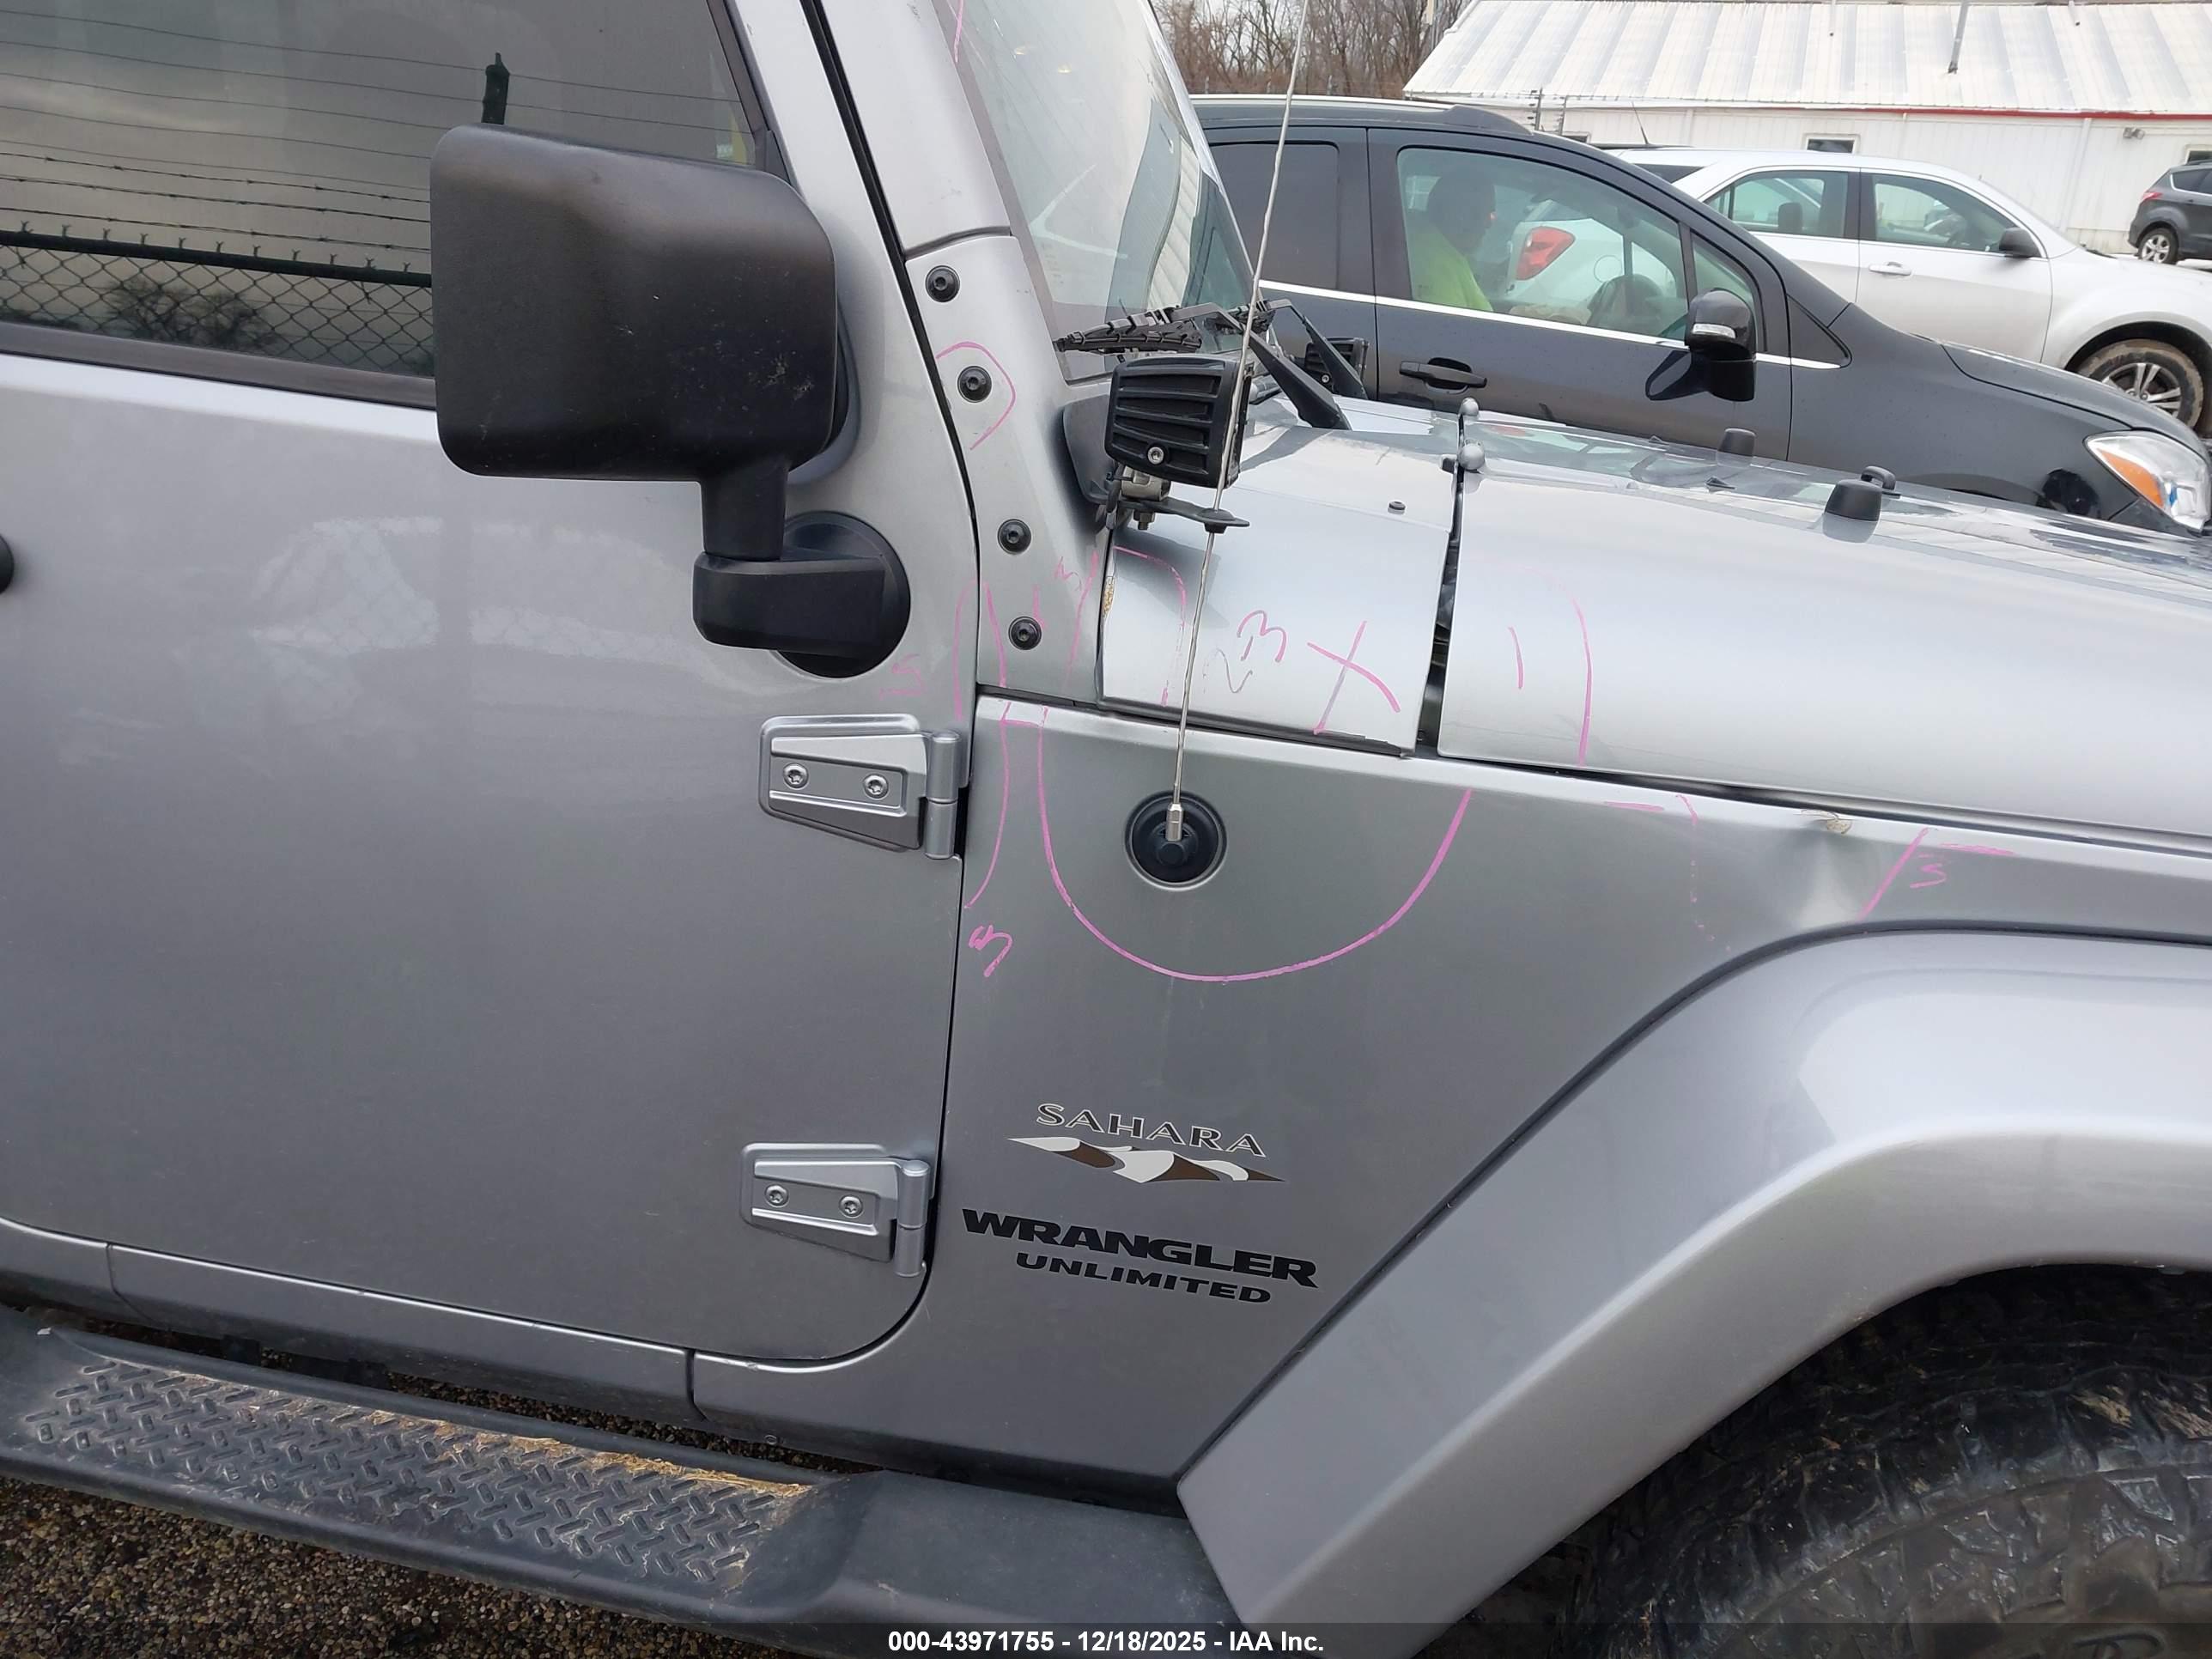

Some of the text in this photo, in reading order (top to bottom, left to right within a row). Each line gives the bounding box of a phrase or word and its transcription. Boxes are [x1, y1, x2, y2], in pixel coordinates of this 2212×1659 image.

[1036, 1103, 1267, 1158] SAHARA
[962, 1208, 1319, 1288] WRANGLER
[1016, 1252, 1271, 1304] UNLIMITED
